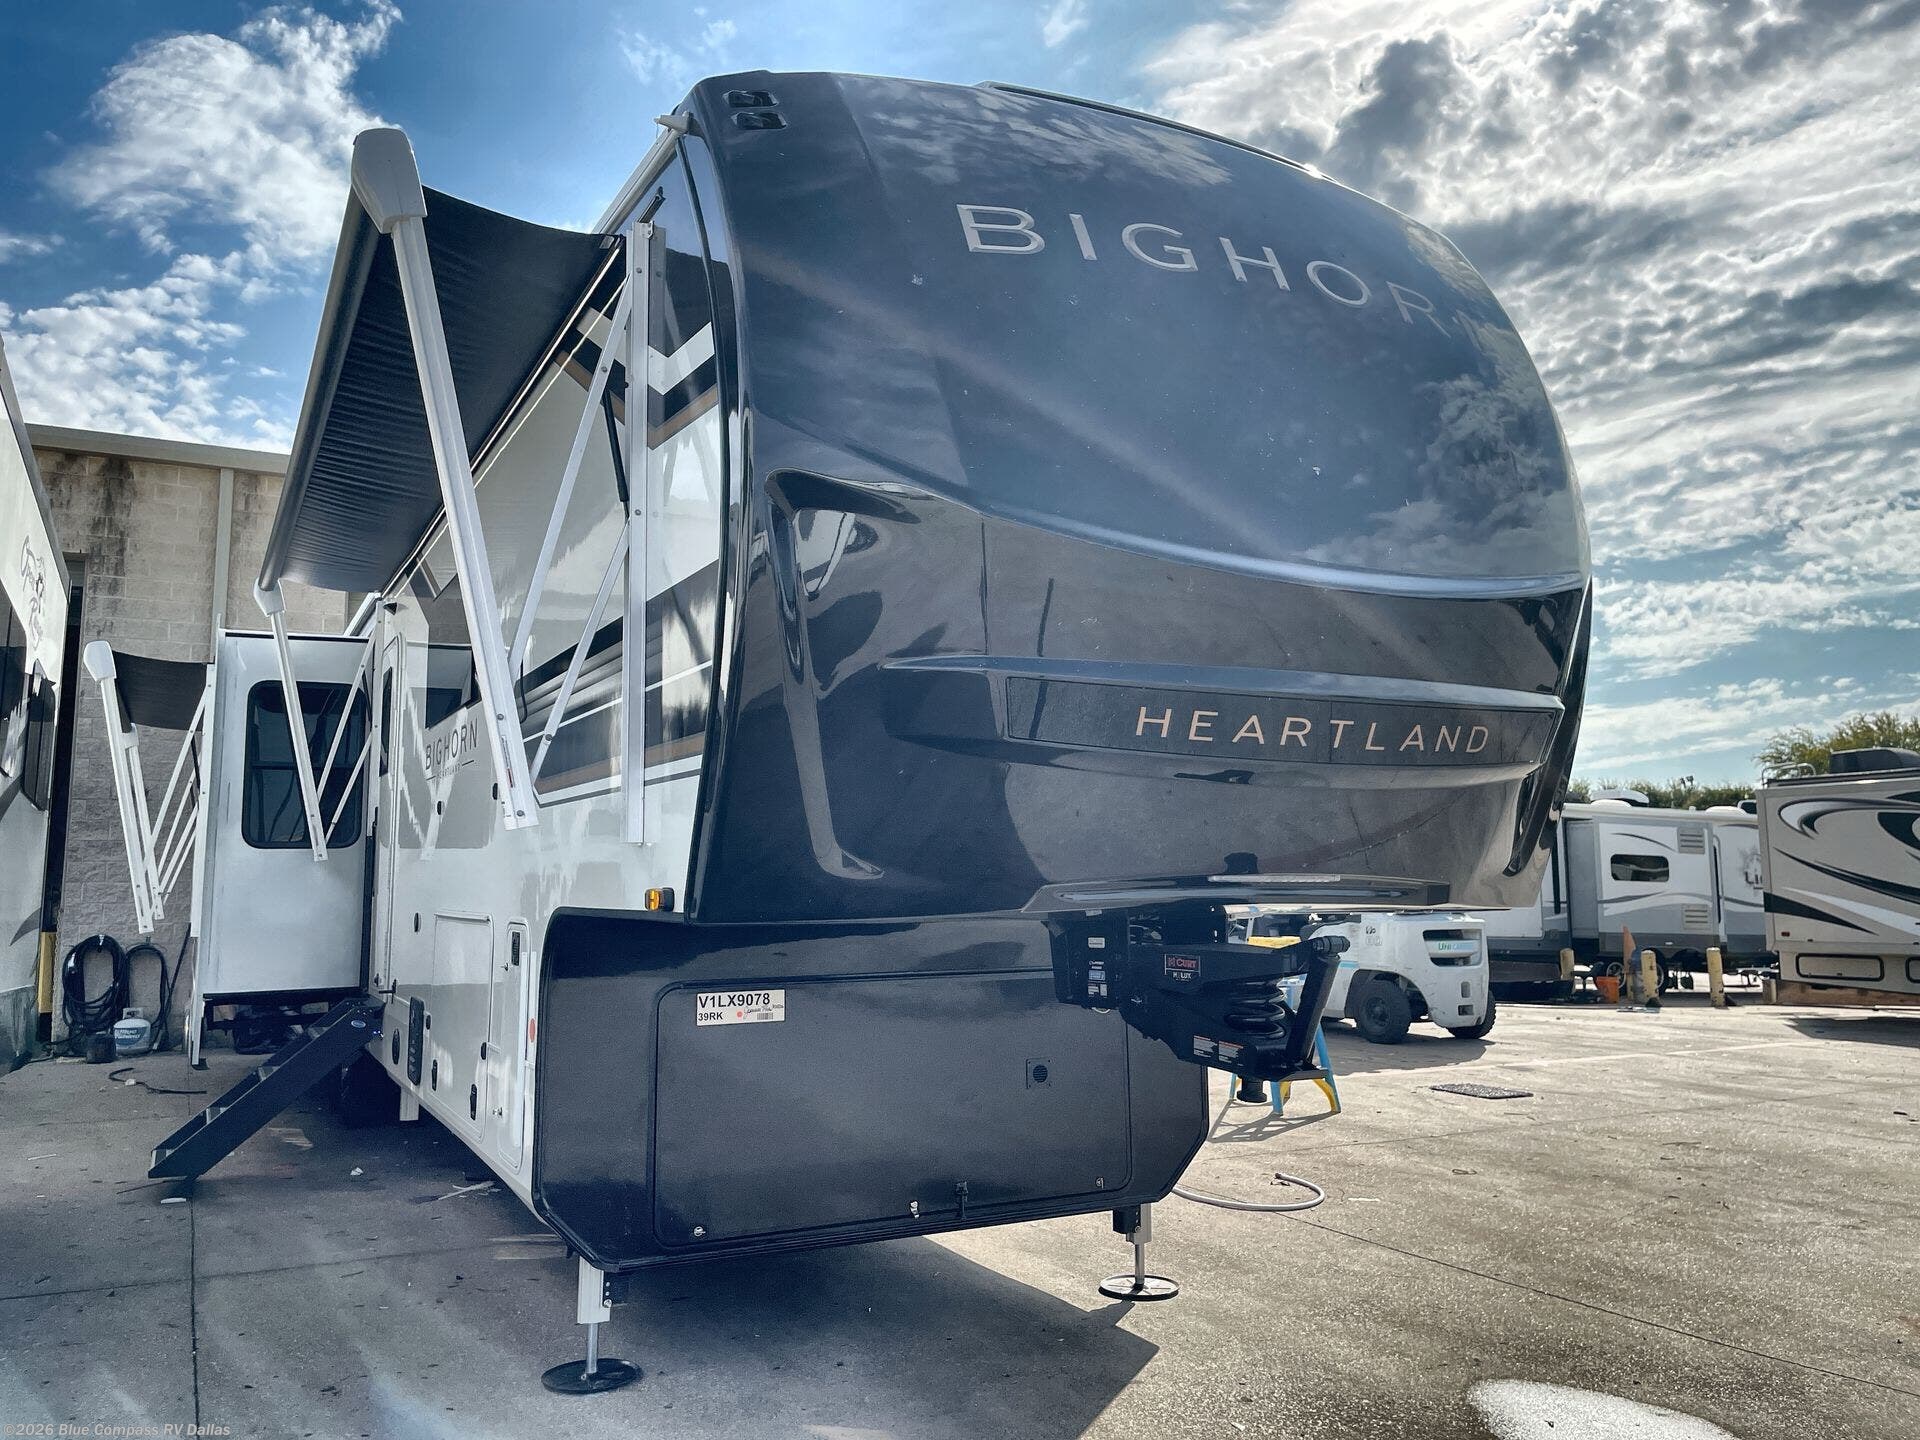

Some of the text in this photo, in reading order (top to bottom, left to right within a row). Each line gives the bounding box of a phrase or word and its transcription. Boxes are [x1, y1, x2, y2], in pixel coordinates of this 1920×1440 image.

[426, 717, 478, 770] BIGHORN
[1135, 706, 1490, 753] HEARTLAND
[698, 993, 771, 1009] V1LX9078
[698, 1012, 724, 1022] 39RK
